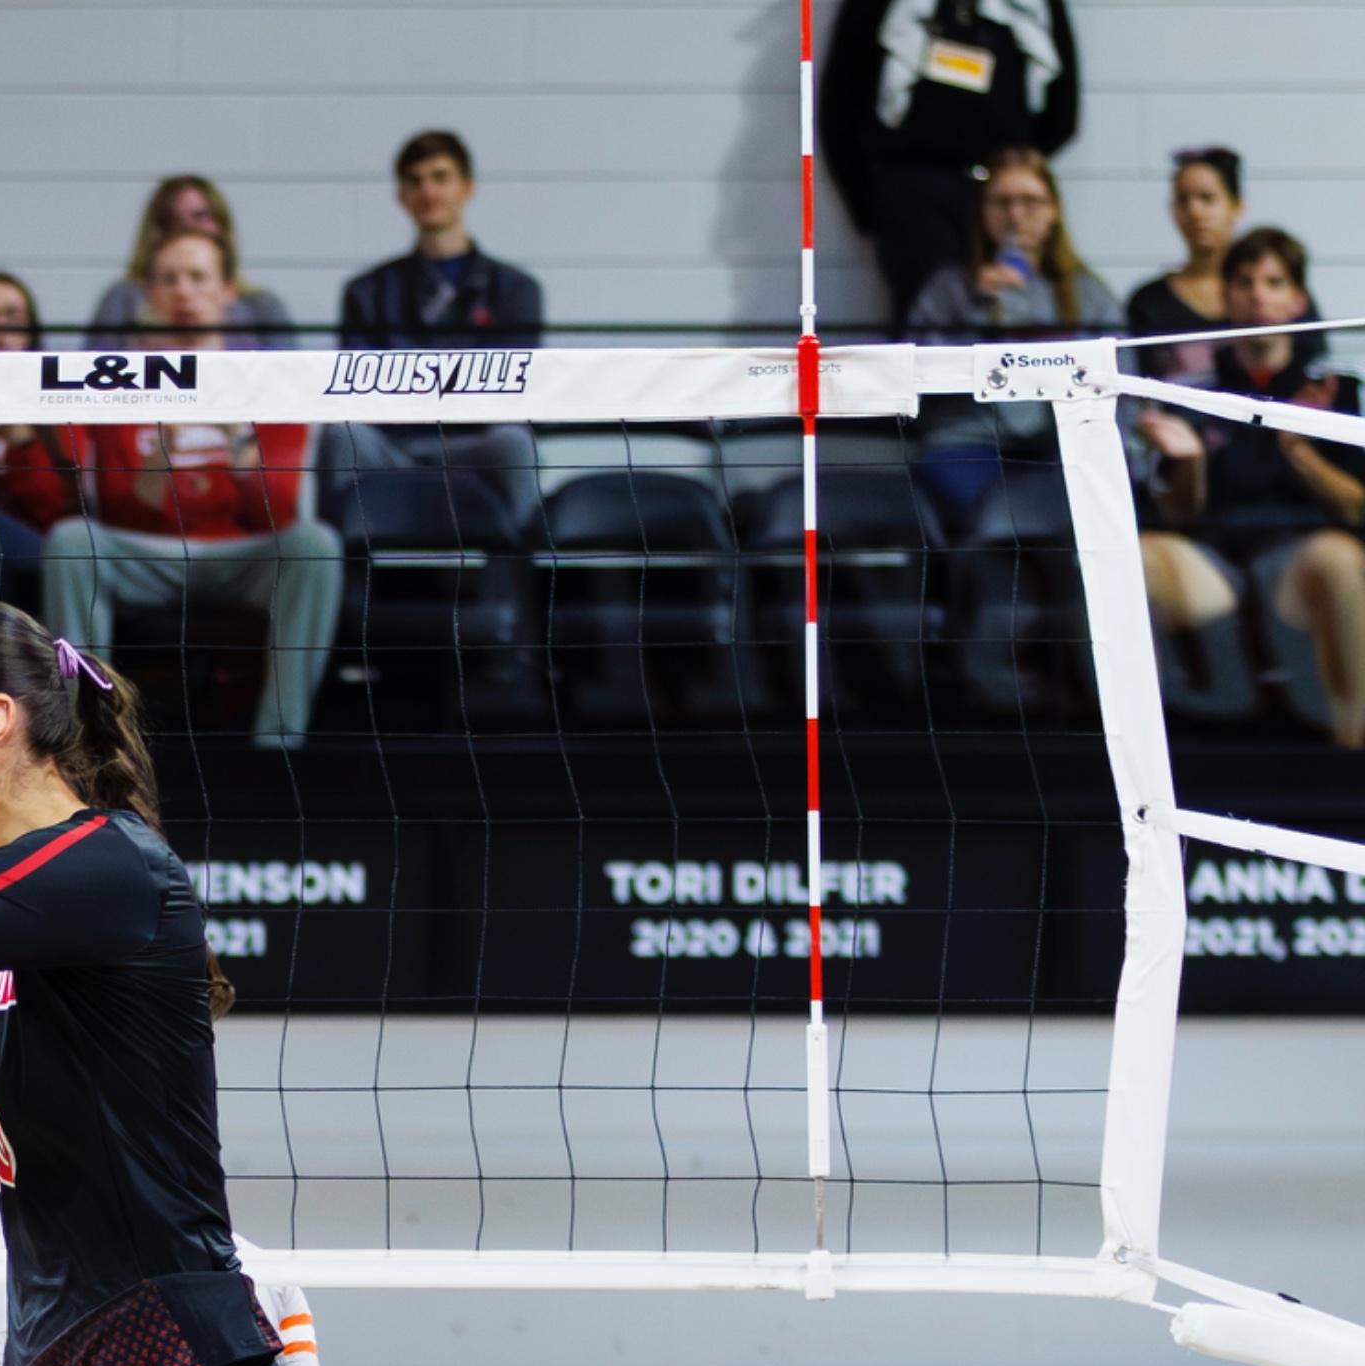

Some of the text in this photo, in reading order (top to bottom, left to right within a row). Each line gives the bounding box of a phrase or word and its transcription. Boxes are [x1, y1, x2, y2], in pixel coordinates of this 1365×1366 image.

[40, 355, 197, 391] L&N
[324, 352, 532, 399] LOUISVILLE
[748, 364, 789, 377] sports
[1017, 353, 1075, 368] Senoh
[39, 394, 198, 405] FEDERAL CREDIT UNION
[603, 861, 909, 905] TORI DILFER
[1188, 859, 1337, 905] ANNA
[630, 918, 883, 959] 2020 & 2021
